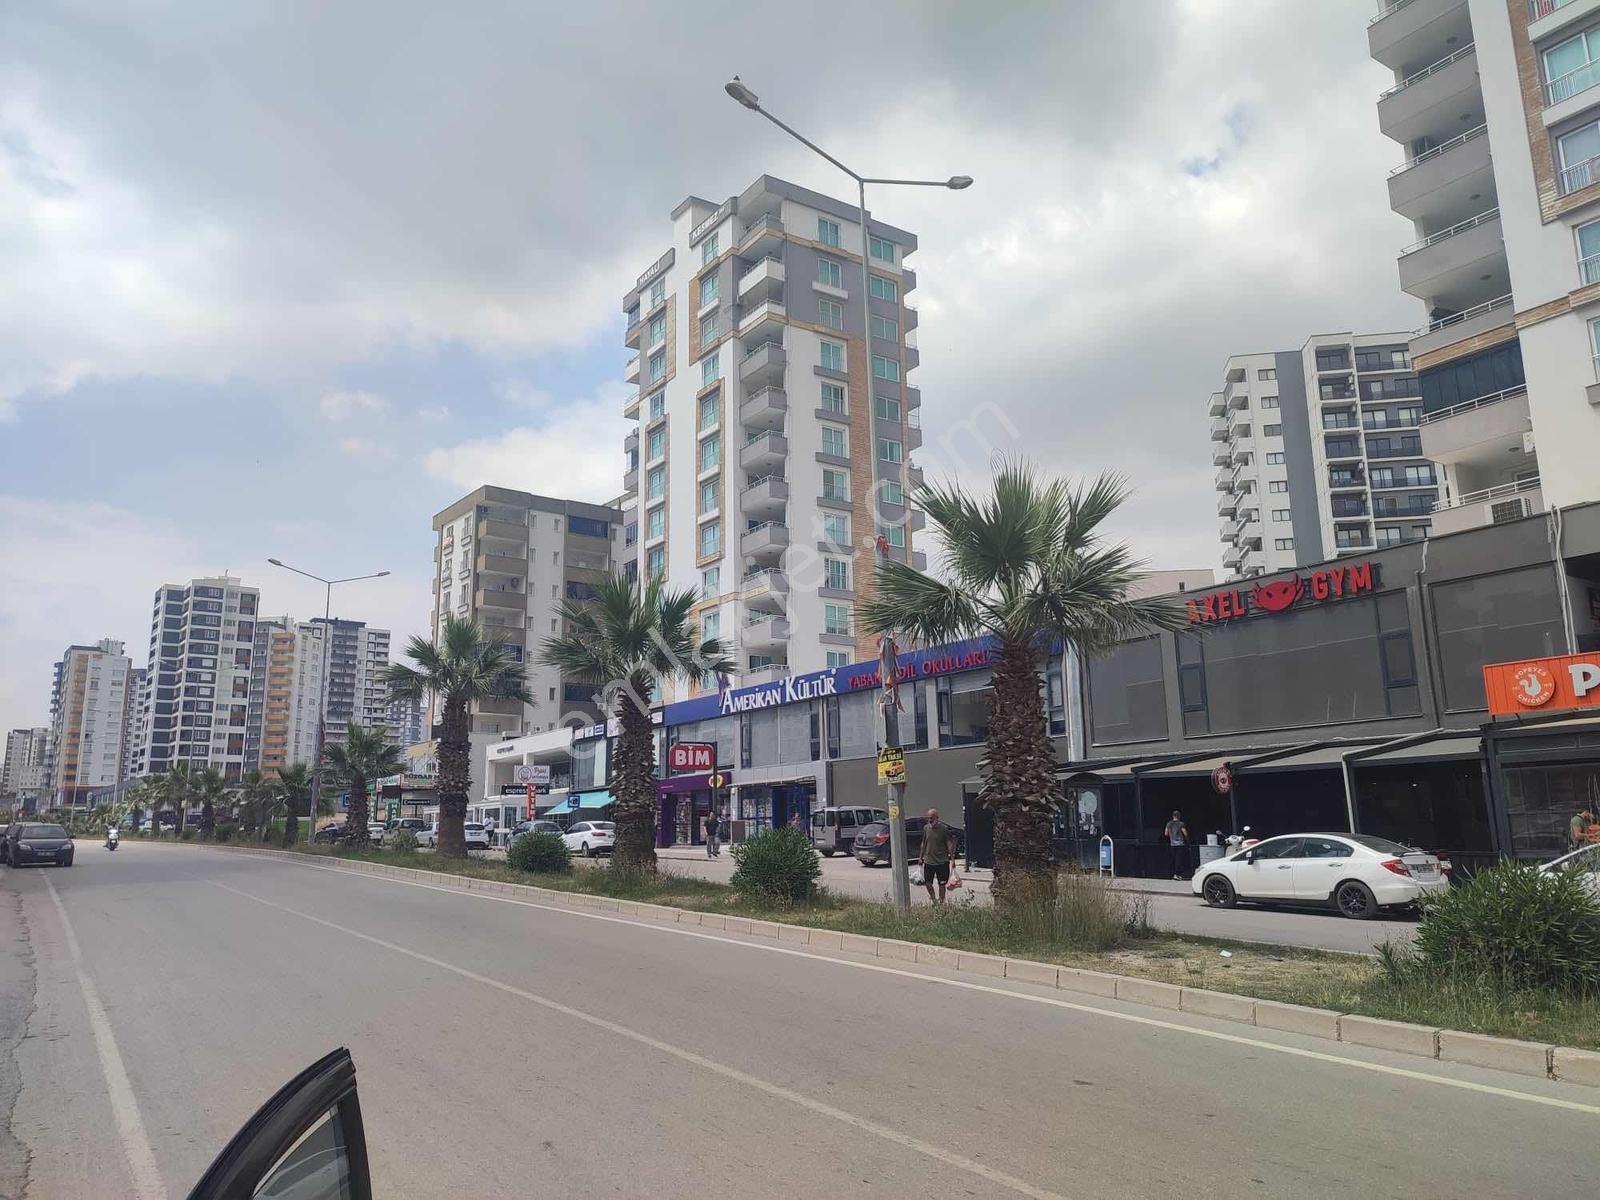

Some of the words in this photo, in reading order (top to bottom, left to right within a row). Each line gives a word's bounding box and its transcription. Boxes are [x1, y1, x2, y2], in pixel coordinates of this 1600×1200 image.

[1185, 588, 1246, 624] AXEL
[1311, 560, 1373, 600] GYM
[1518, 691, 1550, 704] CHICKEN
[675, 746, 710, 766] BİM
